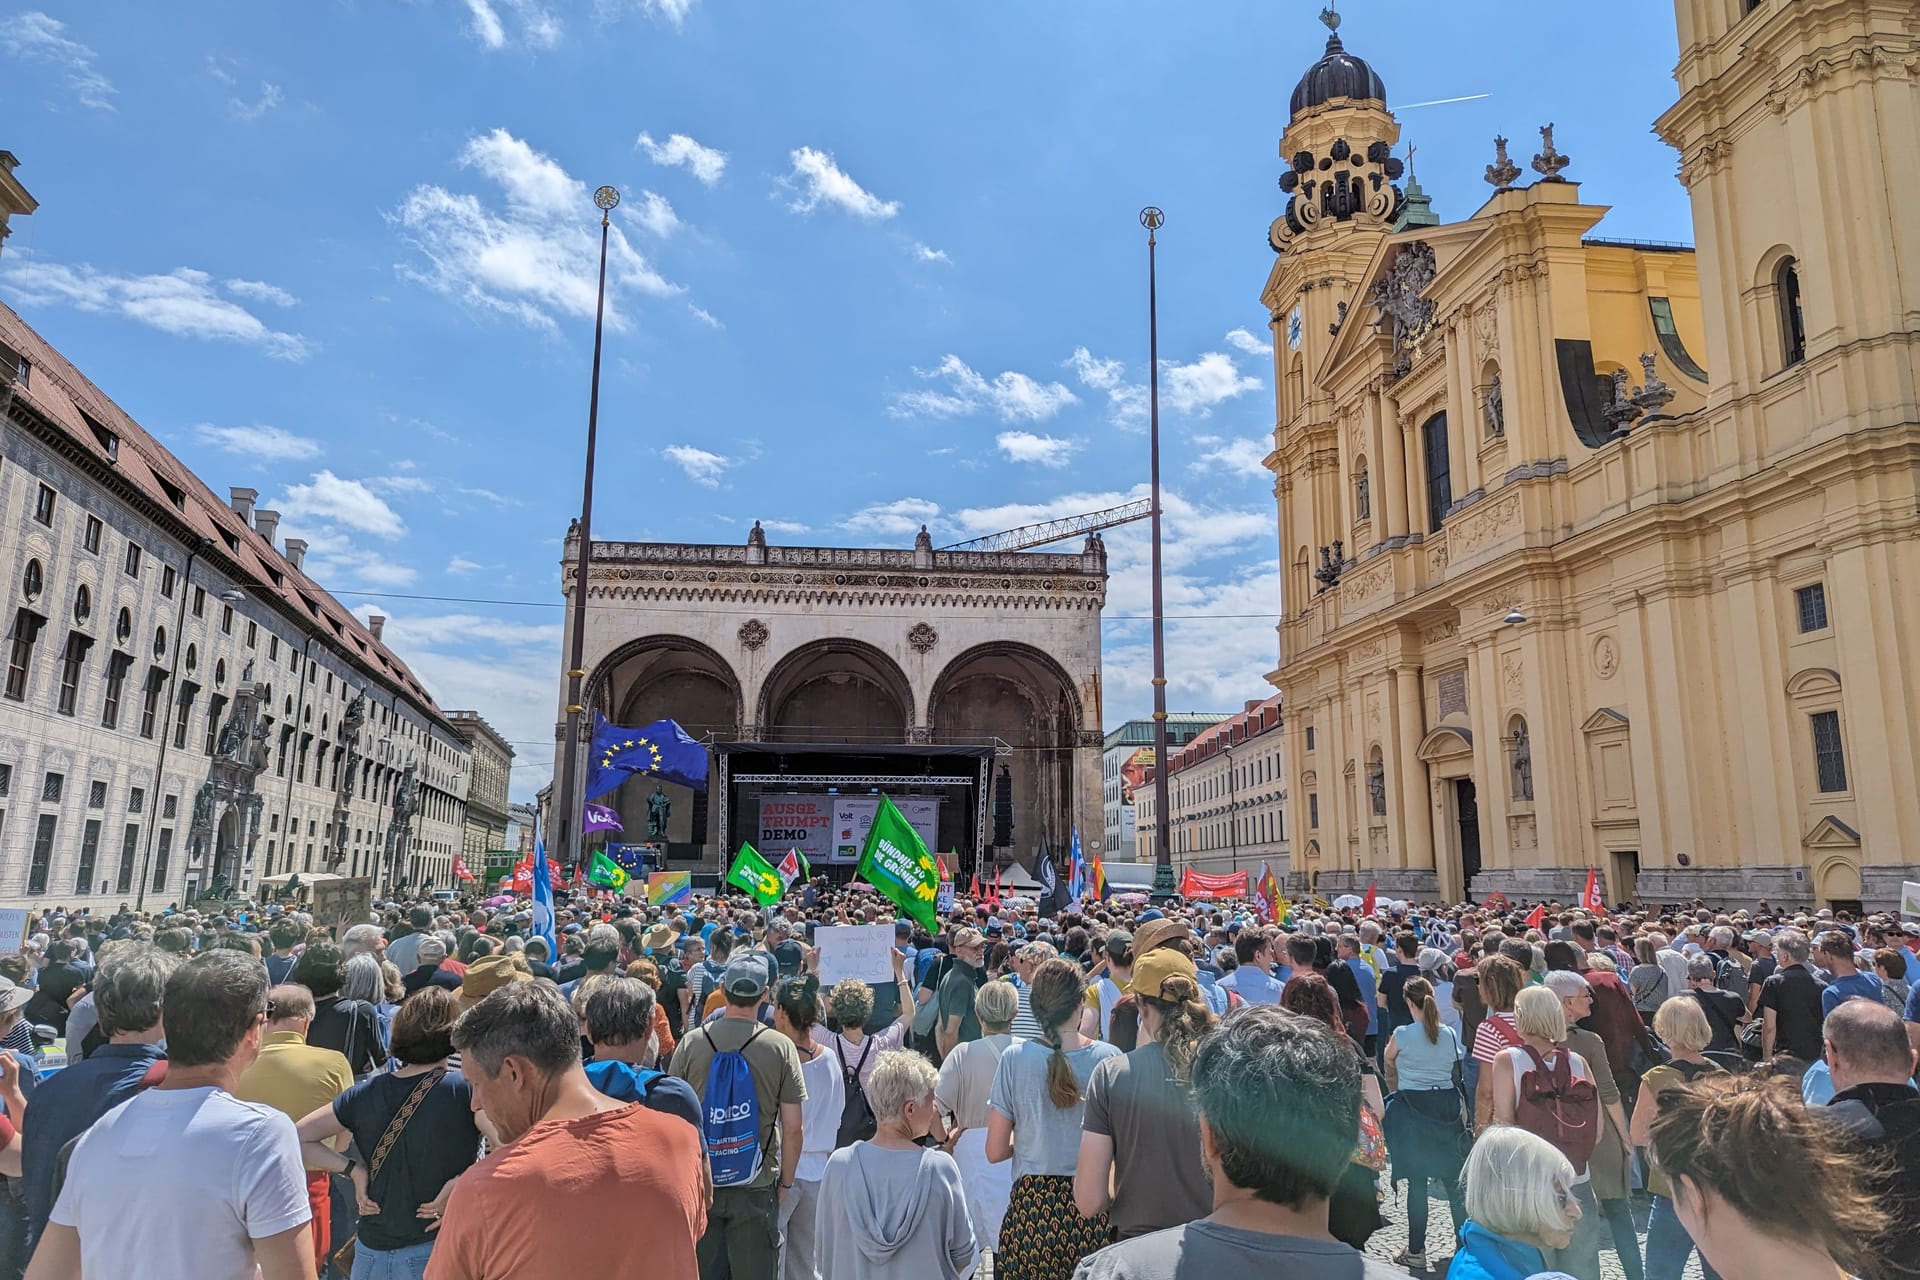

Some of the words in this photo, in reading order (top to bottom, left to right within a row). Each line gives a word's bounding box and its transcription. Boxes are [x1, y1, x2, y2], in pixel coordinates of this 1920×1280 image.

[762, 803, 822, 815] AUSGE-
[762, 816, 830, 828] TRUMPT
[761, 829, 807, 841] DEMO
[878, 838, 916, 870] BÜNDNIS
[913, 866, 925, 879] 90
[874, 849, 885, 863] DIE
[883, 858, 921, 889] GRÜNEN
